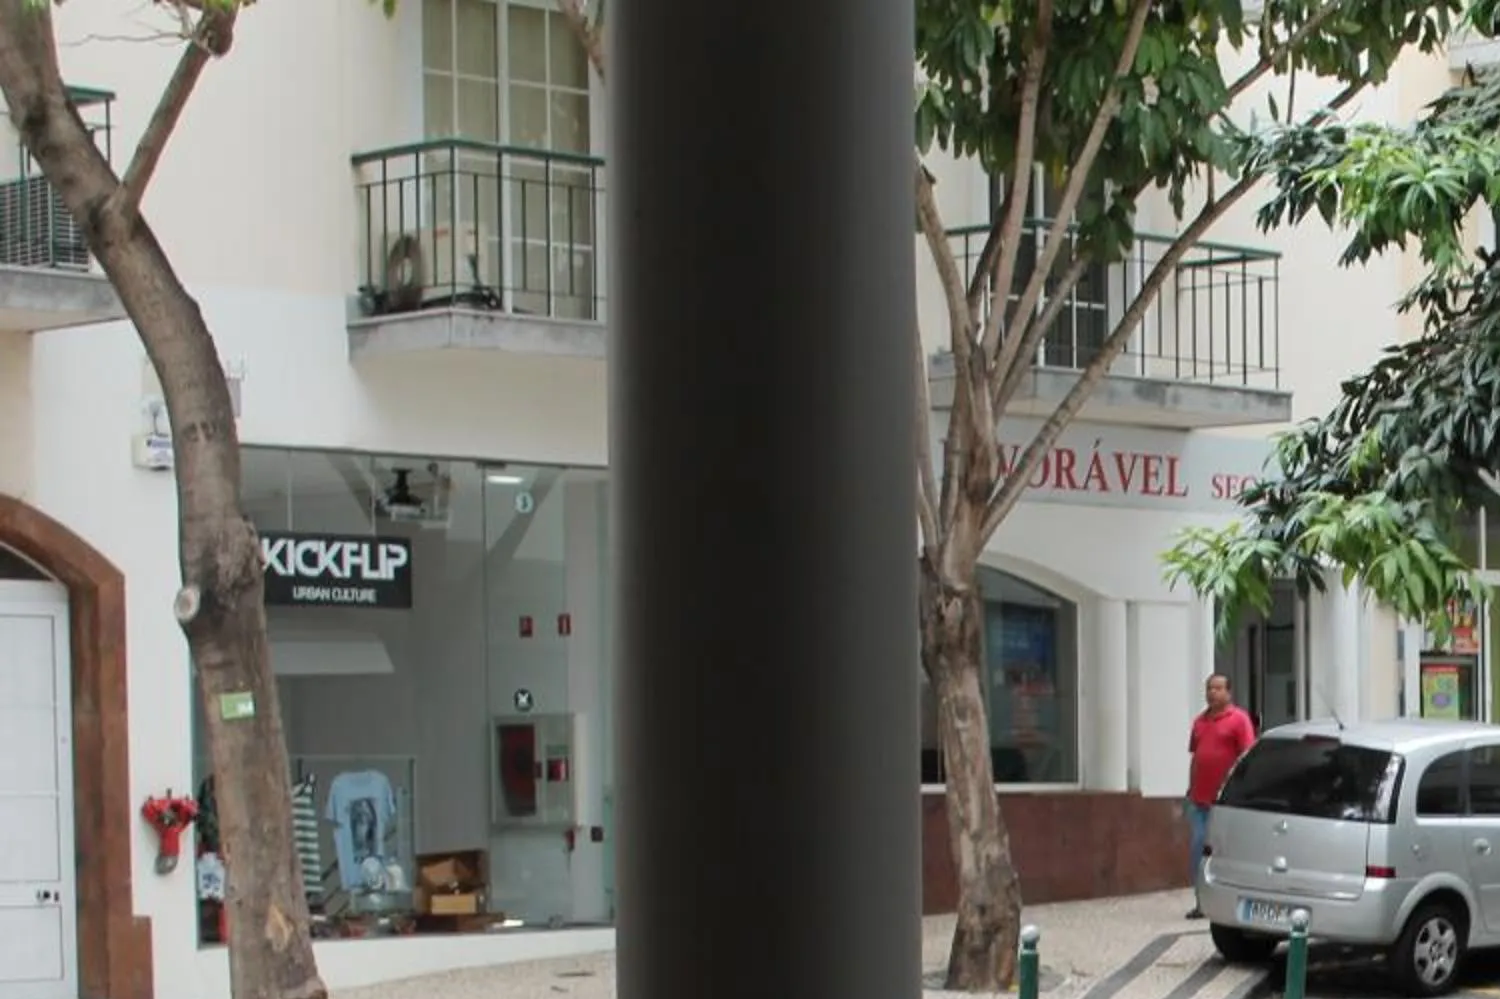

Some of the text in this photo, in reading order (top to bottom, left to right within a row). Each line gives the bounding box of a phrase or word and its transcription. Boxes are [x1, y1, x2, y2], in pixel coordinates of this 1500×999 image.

[262, 537, 409, 581] KICKFLIP
[292, 586, 378, 604] URBAN CULTURE
